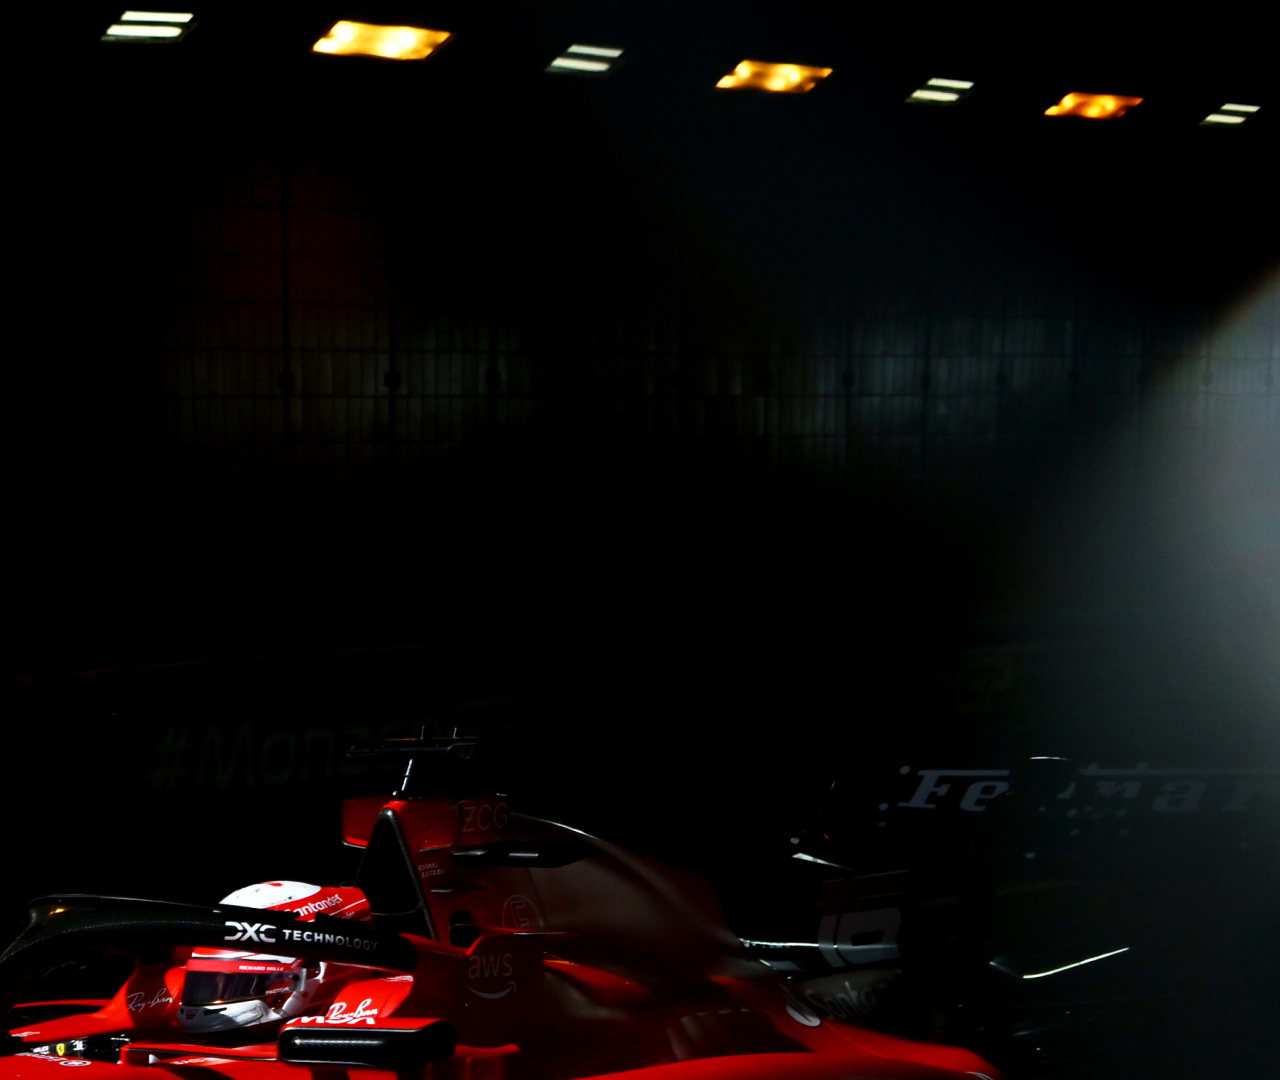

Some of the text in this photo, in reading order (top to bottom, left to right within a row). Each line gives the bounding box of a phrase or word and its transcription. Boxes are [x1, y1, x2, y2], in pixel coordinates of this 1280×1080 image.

[223, 920, 380, 952] DXC TECHNOLOGY
[467, 952, 513, 980] aws
